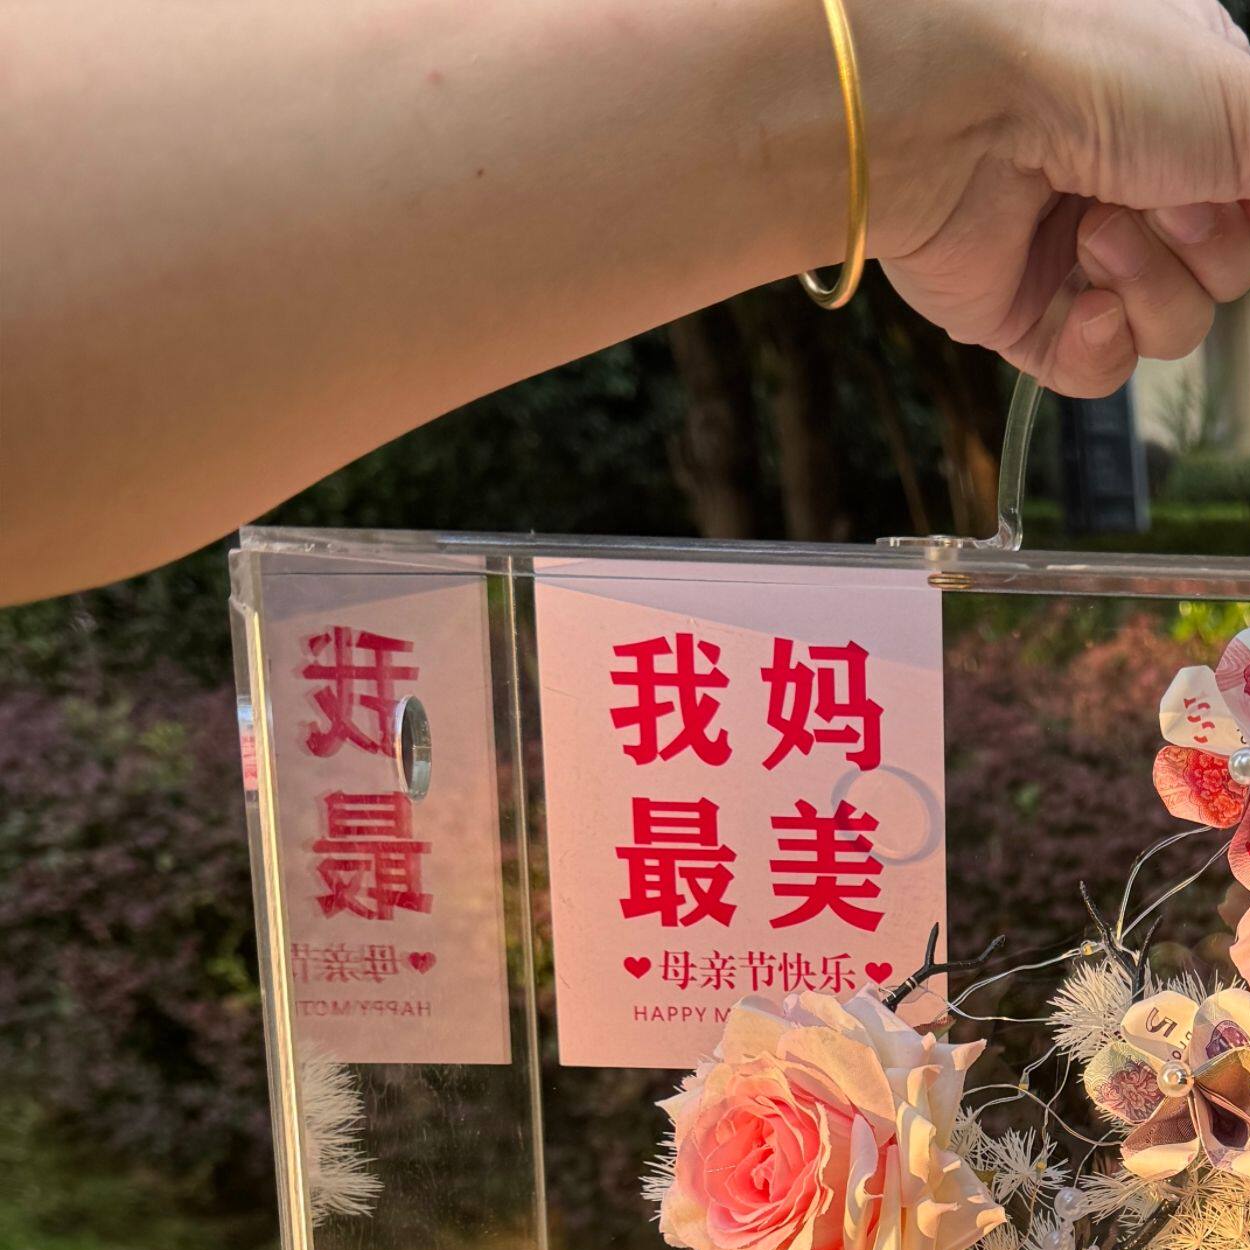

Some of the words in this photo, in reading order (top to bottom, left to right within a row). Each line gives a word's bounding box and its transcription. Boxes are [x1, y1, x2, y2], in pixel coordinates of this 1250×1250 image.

[610, 633, 884, 771] 我妈
[615, 796, 886, 933] 最美
[634, 1005, 706, 1023] HAPPY
[659, 950, 856, 994] 母亲节快乐
